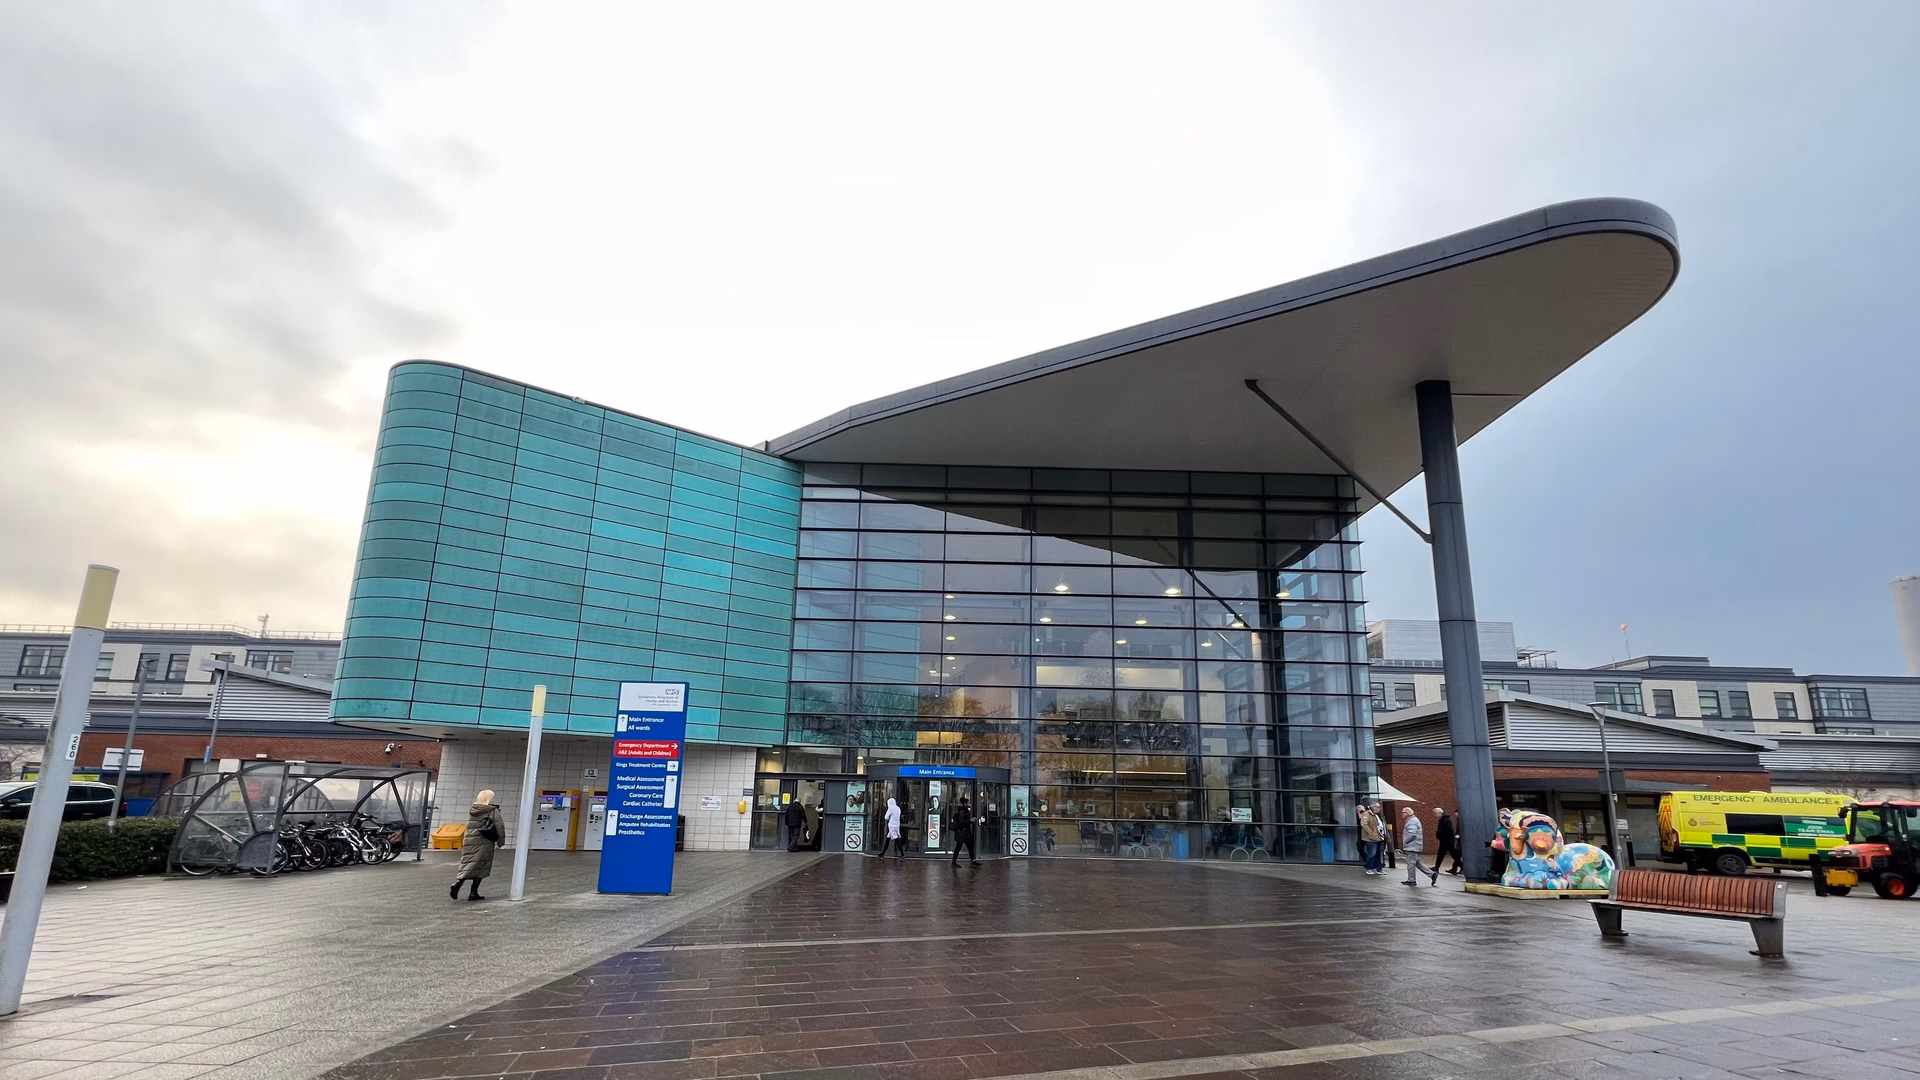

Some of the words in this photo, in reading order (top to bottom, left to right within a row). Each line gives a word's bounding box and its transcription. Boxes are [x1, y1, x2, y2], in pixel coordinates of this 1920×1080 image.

[70, 736, 79, 758] 260
[1693, 794, 1756, 802] EMERGENCY
[1763, 796, 1832, 804] AMBULANCE
